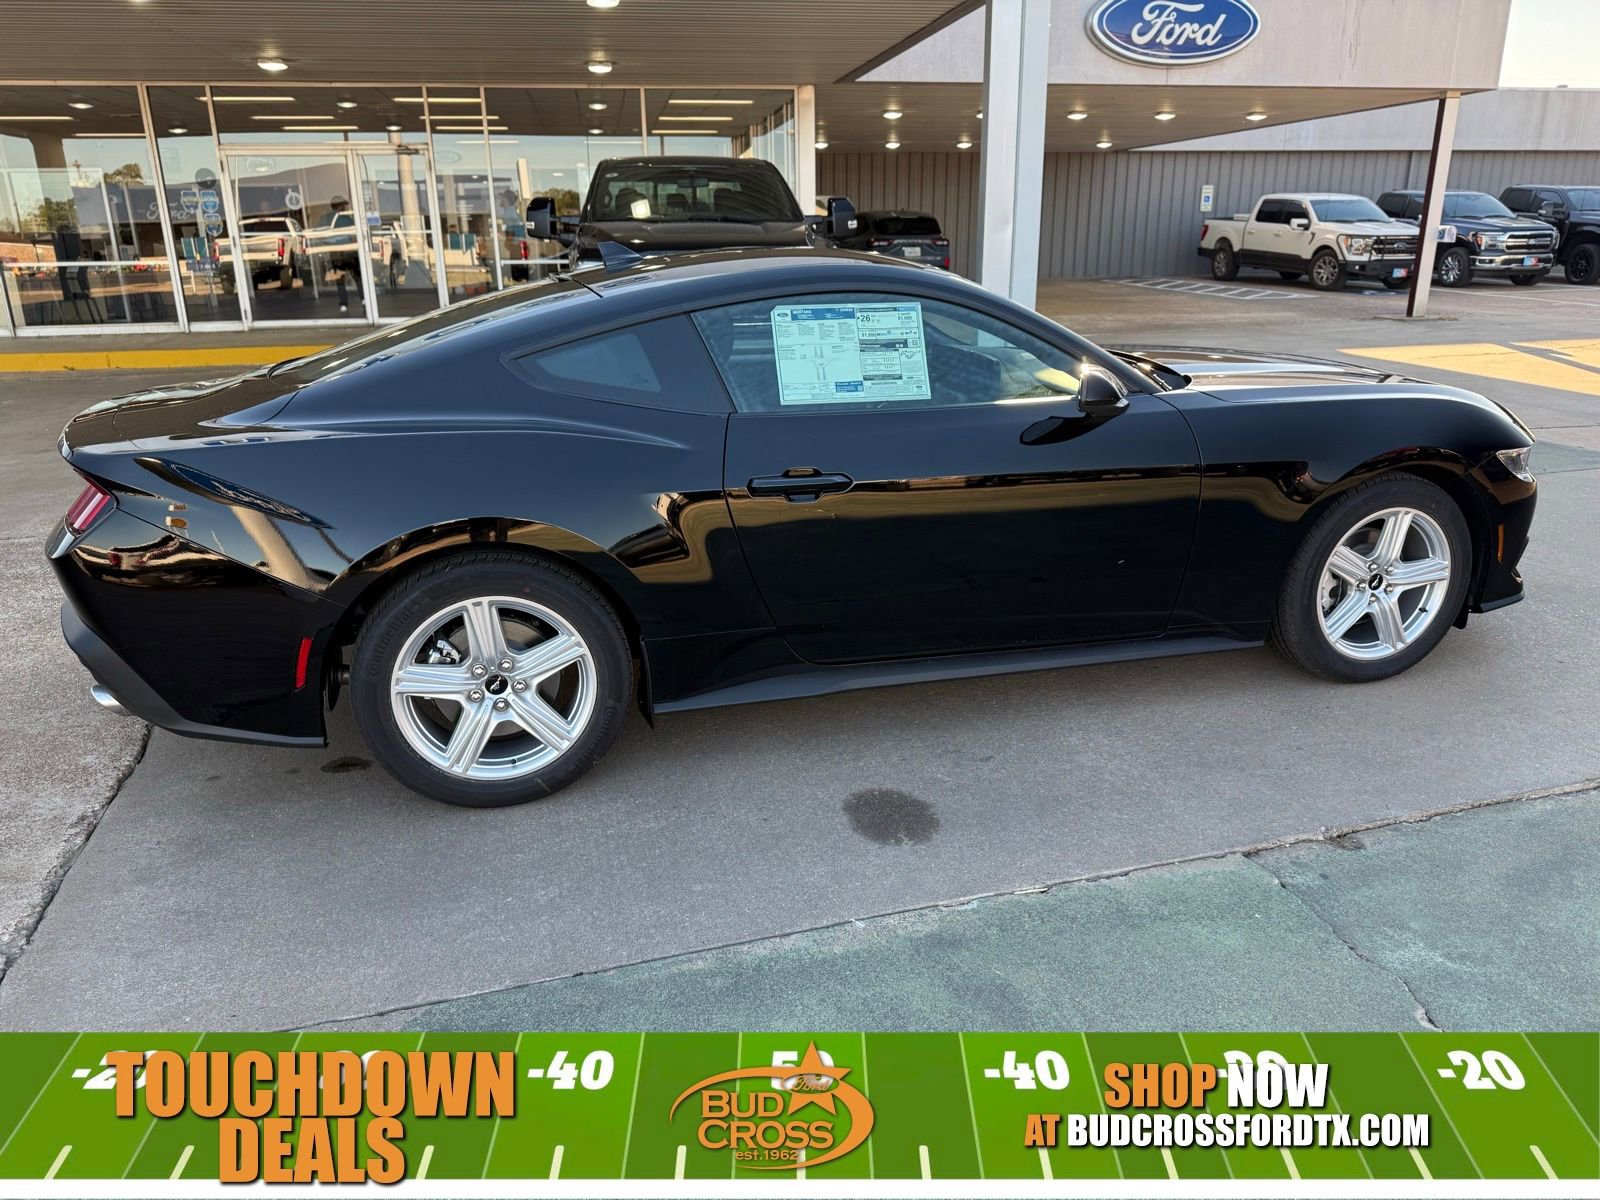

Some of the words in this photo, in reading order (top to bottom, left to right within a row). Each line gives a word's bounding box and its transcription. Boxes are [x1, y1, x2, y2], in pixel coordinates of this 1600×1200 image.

[1131, 1, 1227, 46] Ford
[147, 202, 190, 219] Frd
[860, 314, 871, 322] 26
